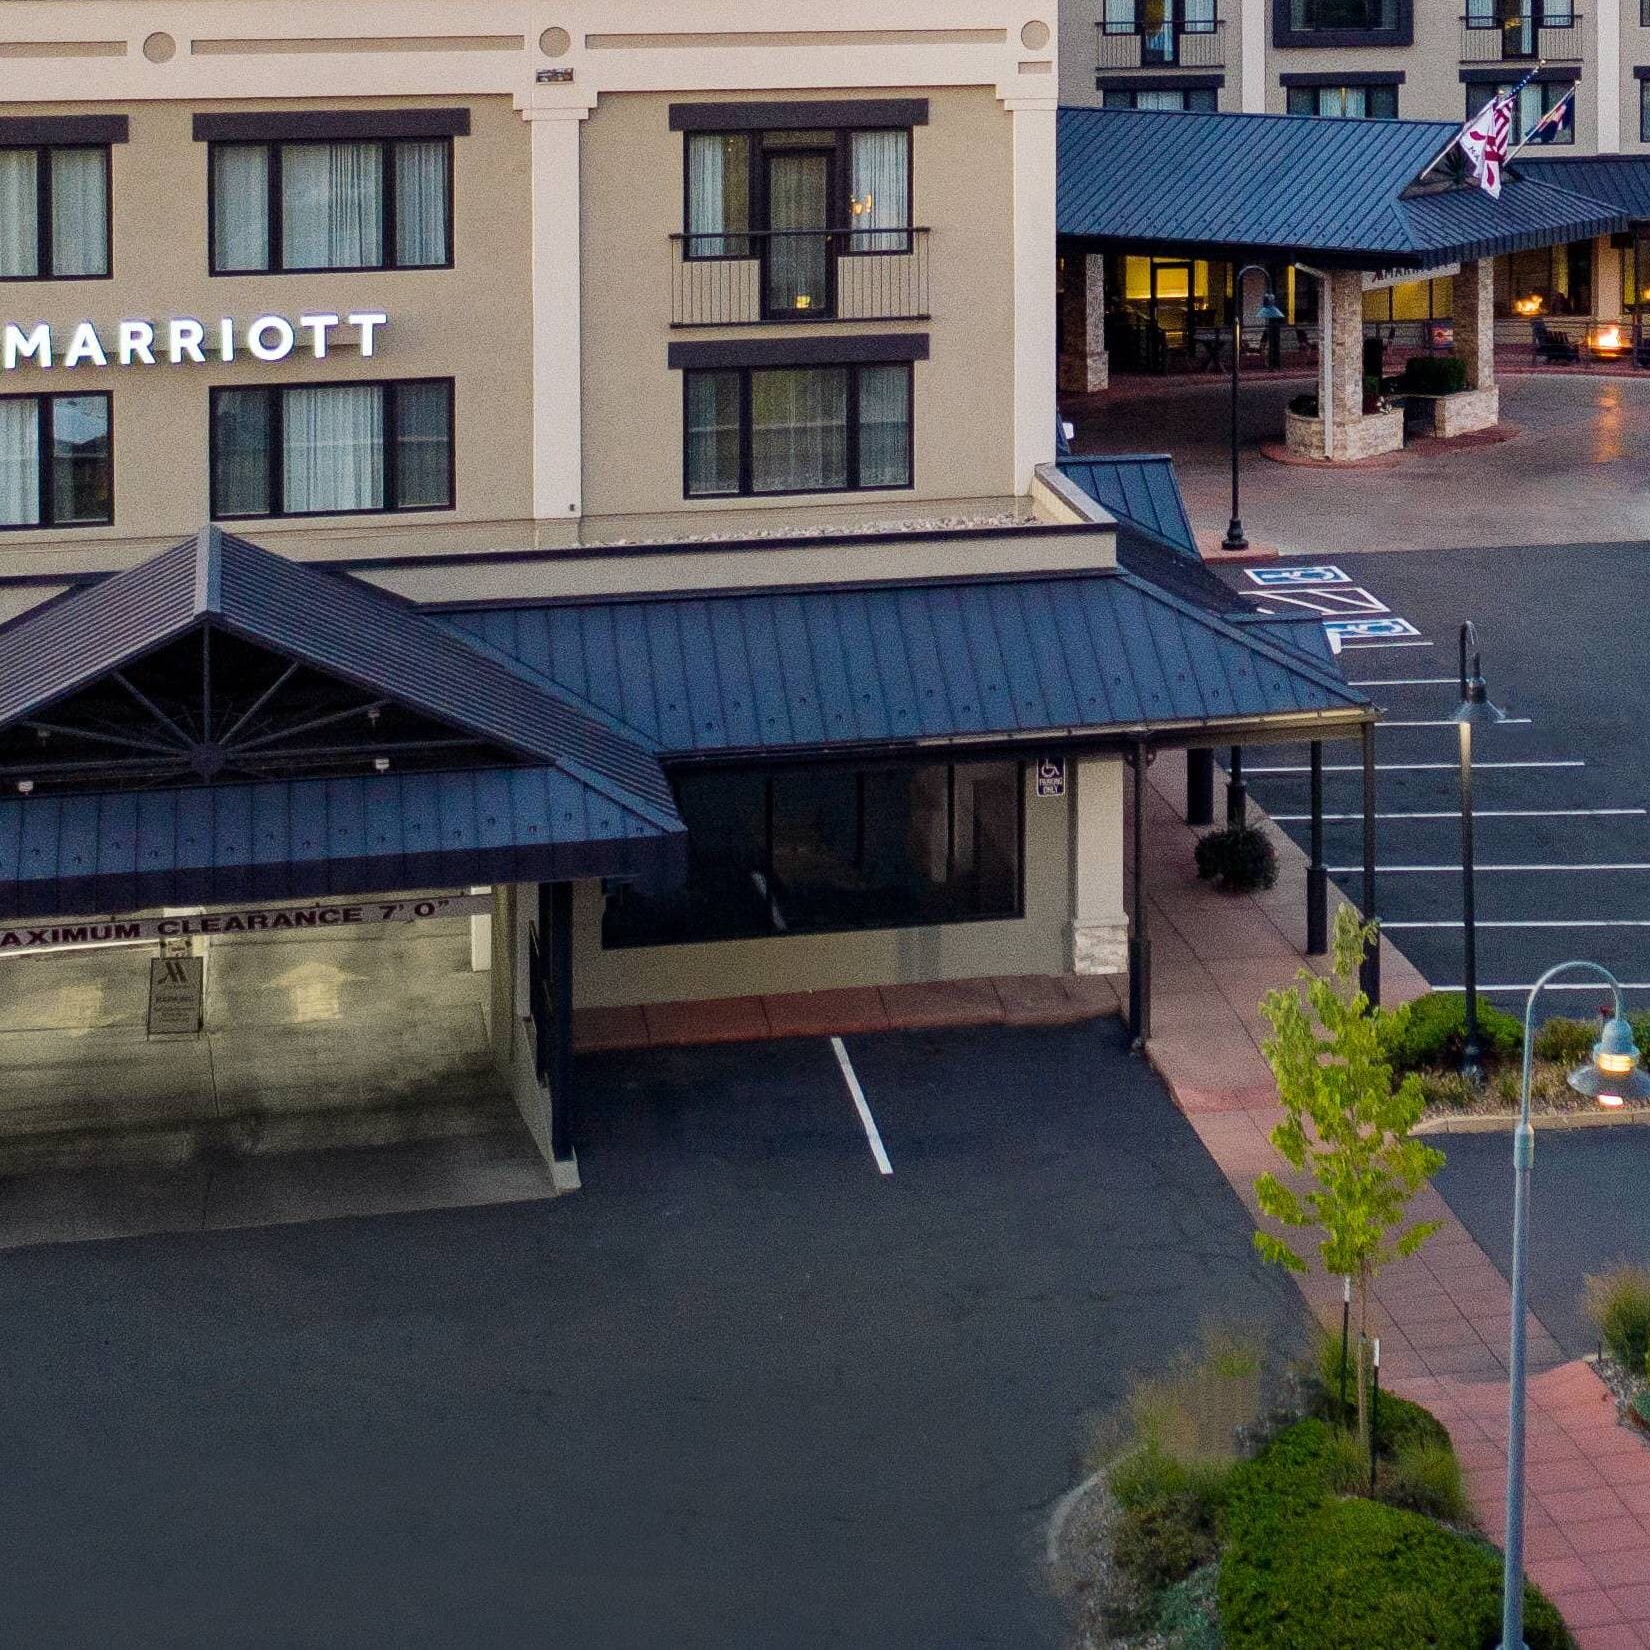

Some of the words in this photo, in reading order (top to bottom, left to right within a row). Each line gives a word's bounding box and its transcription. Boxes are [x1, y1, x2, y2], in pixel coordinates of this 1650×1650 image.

[3, 311, 387, 370] MARRIOTT
[0, 923, 140, 946] AXIMUM
[157, 907, 362, 935] CLEARANCE
